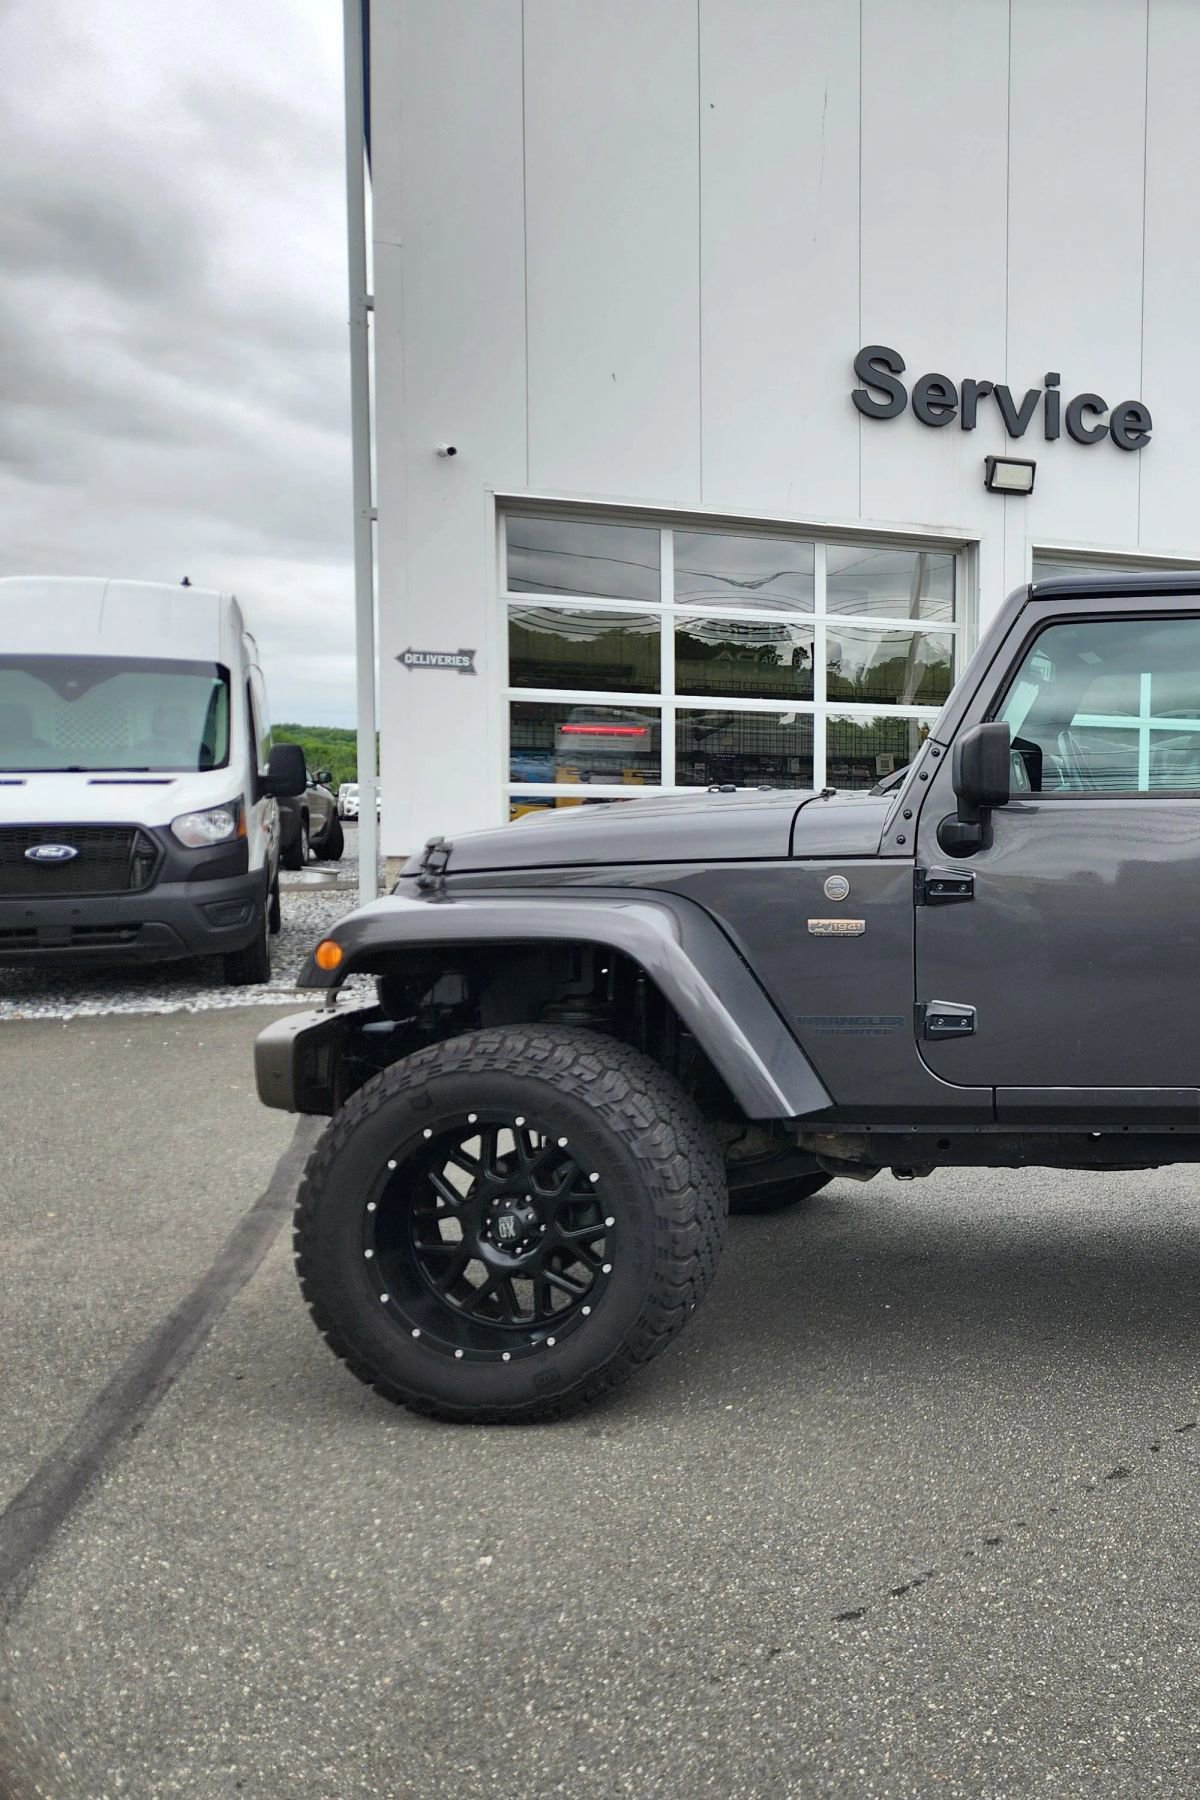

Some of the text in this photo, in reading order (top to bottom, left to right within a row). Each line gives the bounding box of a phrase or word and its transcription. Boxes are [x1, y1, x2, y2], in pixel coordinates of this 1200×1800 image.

[851, 345, 1153, 451] Service
[404, 653, 470, 666] DELIVERIES
[832, 923, 862, 931] 1941
